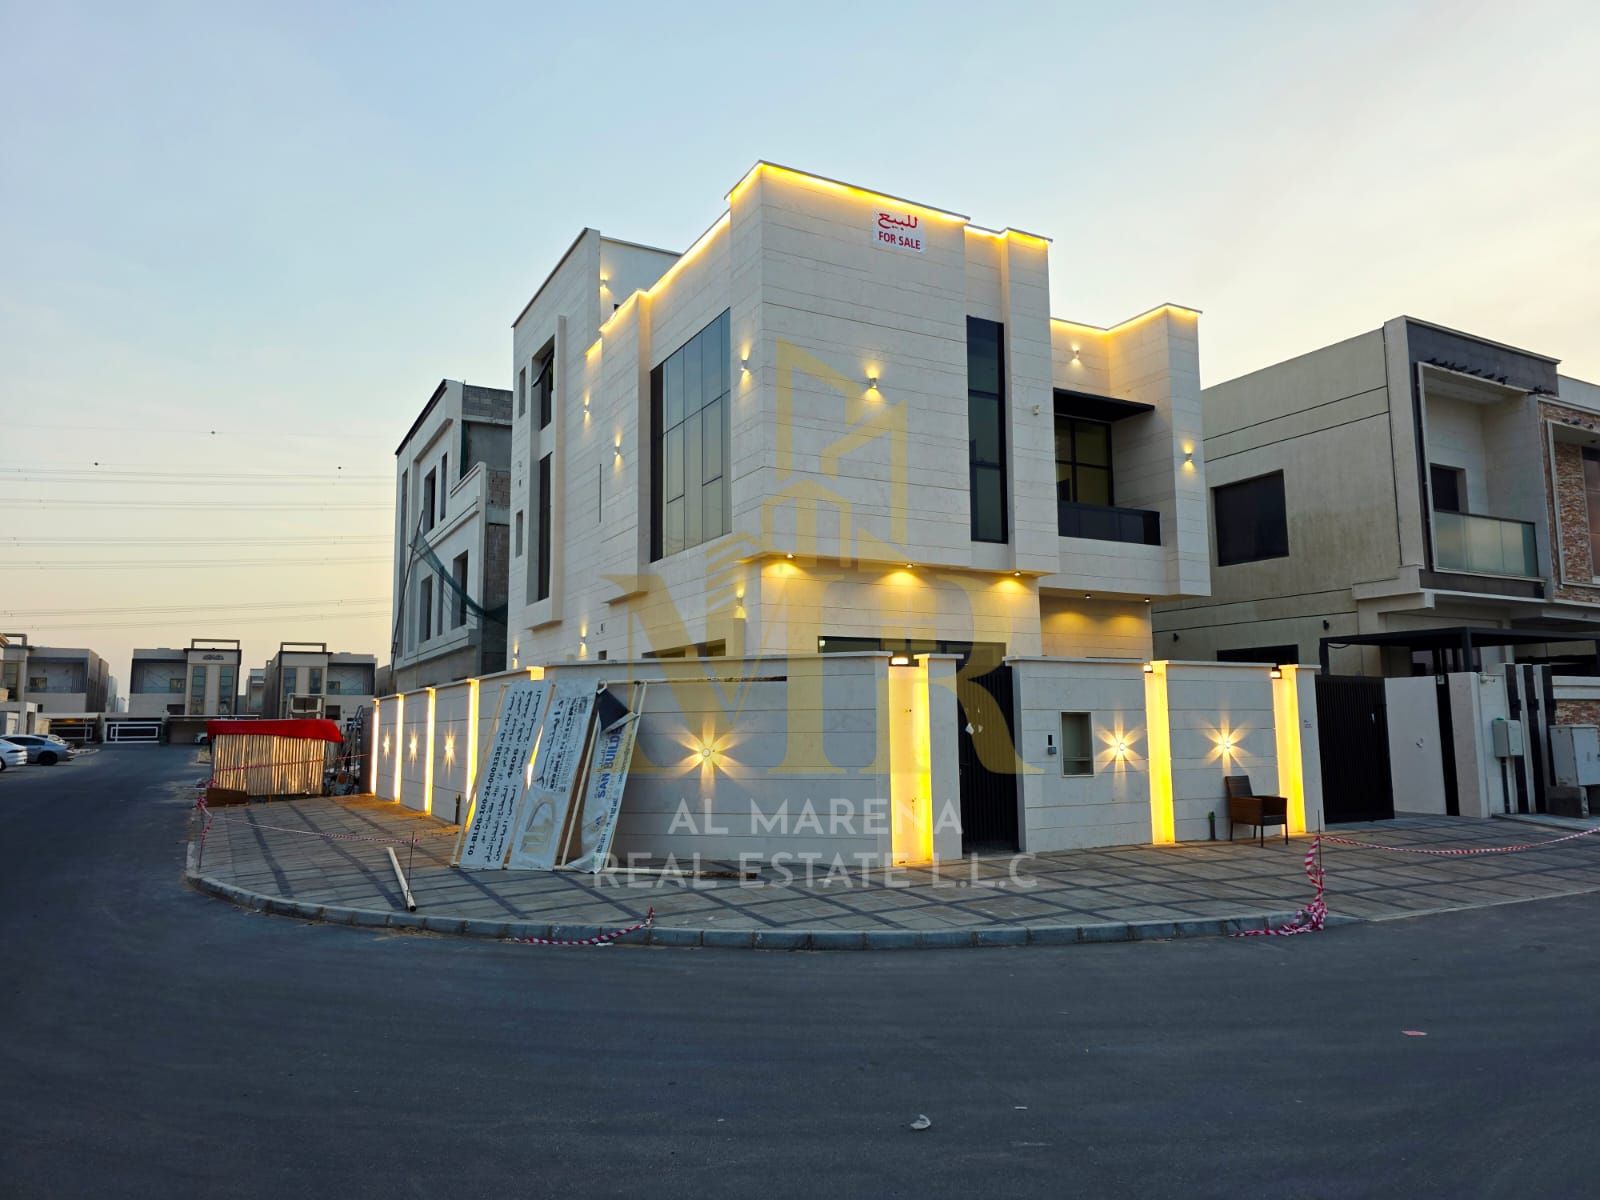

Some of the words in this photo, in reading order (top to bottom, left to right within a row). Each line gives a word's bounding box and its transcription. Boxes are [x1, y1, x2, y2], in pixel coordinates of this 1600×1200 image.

[878, 213, 918, 231] للبيع
[878, 231, 897, 245] FOR
[898, 236, 921, 250] SALE
[597, 772, 610, 798] SAN
